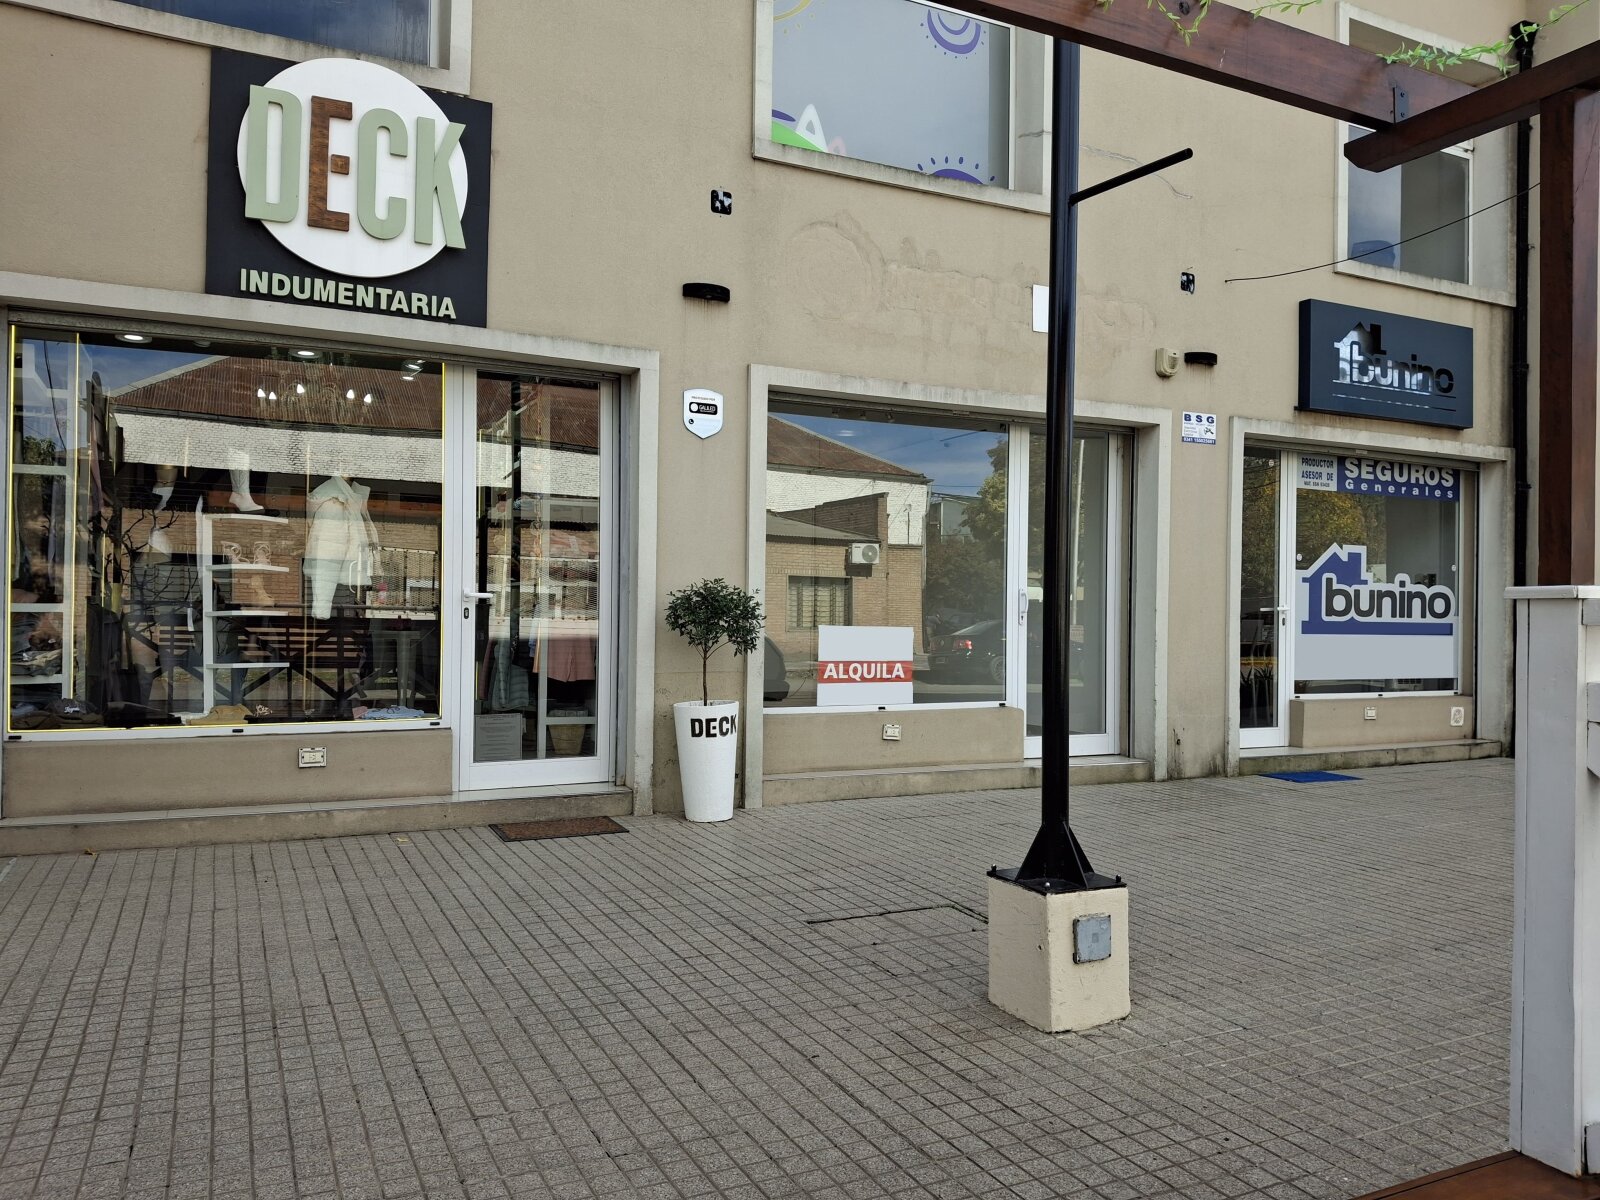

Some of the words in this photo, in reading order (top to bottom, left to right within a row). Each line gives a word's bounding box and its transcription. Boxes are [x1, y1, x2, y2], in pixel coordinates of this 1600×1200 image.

[245, 84, 467, 249] DECK
[240, 268, 457, 319] INDUMENTARIA
[1352, 343, 1454, 394] bunino
[1301, 457, 1334, 469] PRODUCTOR
[1301, 470, 1323, 480] ASESOR
[1326, 472, 1334, 481] DE
[1344, 457, 1454, 487] SEGUROS
[1345, 479, 1453, 499] Generales
[1325, 577, 1451, 619] bunino
[823, 662, 905, 681] ALQUILA
[690, 714, 737, 738] DECK
